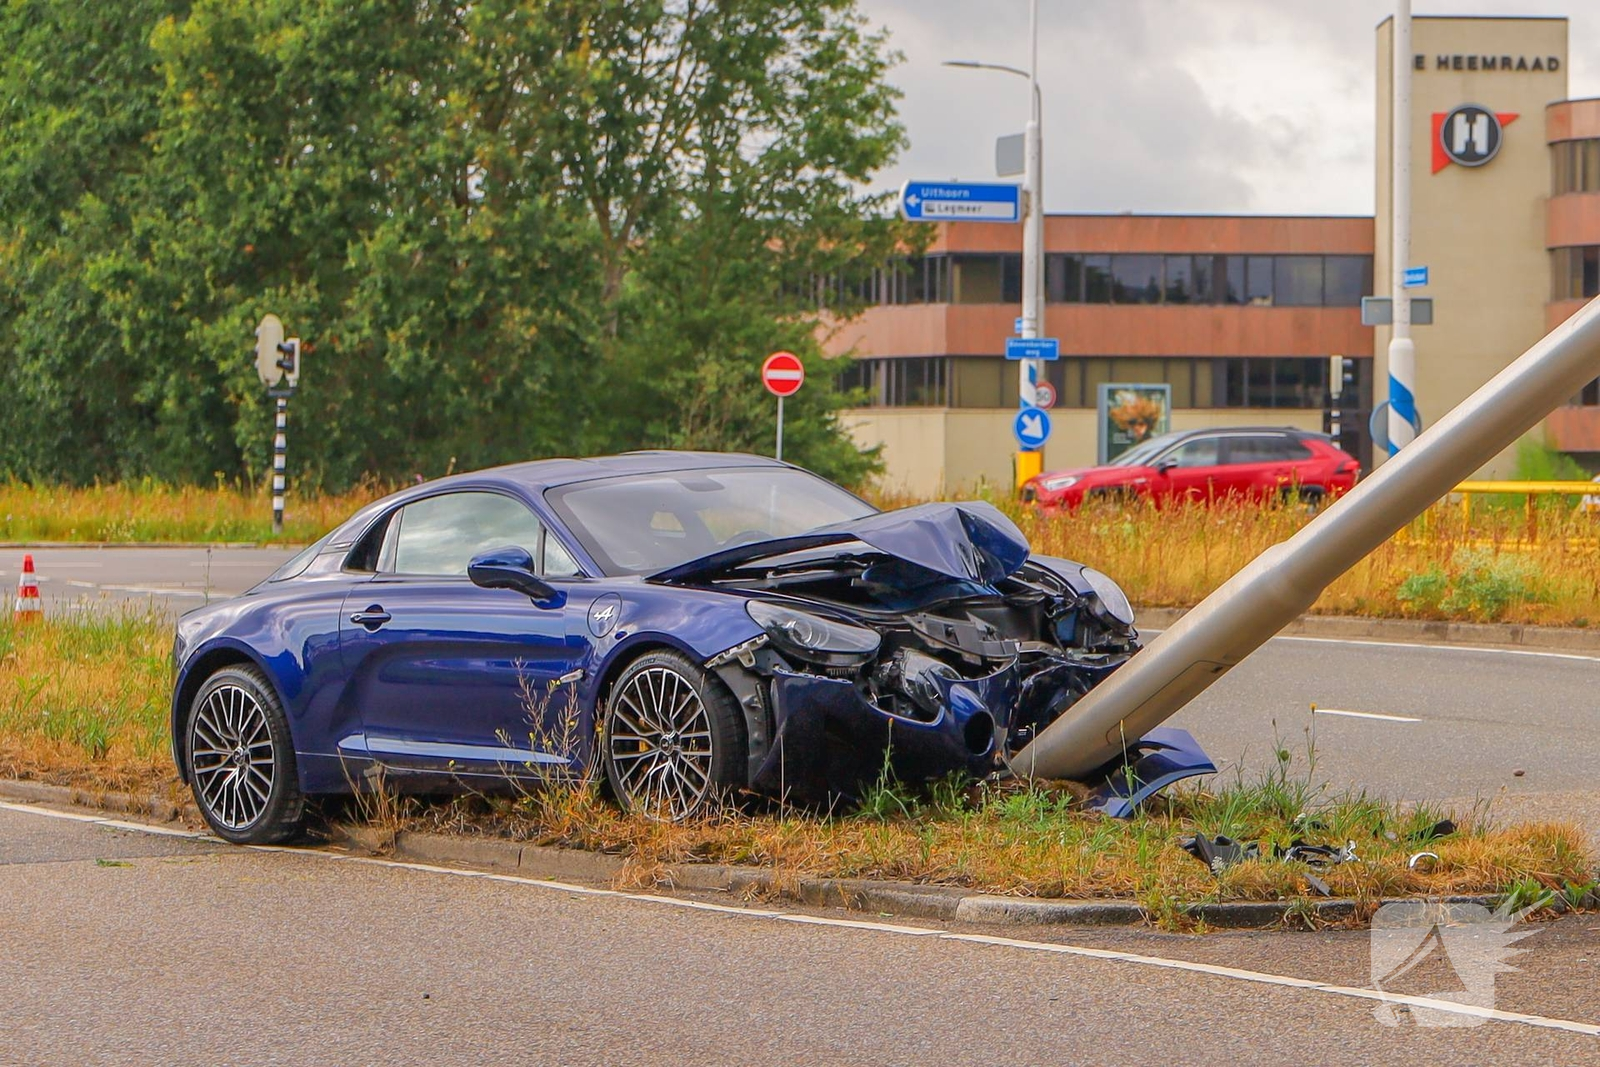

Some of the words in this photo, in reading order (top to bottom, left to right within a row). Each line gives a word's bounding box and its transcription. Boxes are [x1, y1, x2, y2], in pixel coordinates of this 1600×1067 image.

[1413, 54, 1425, 70] E
[1437, 55, 1560, 71] HEEMRAAD
[921, 187, 970, 198] Uithoorn
[937, 203, 982, 216] Legmeer
